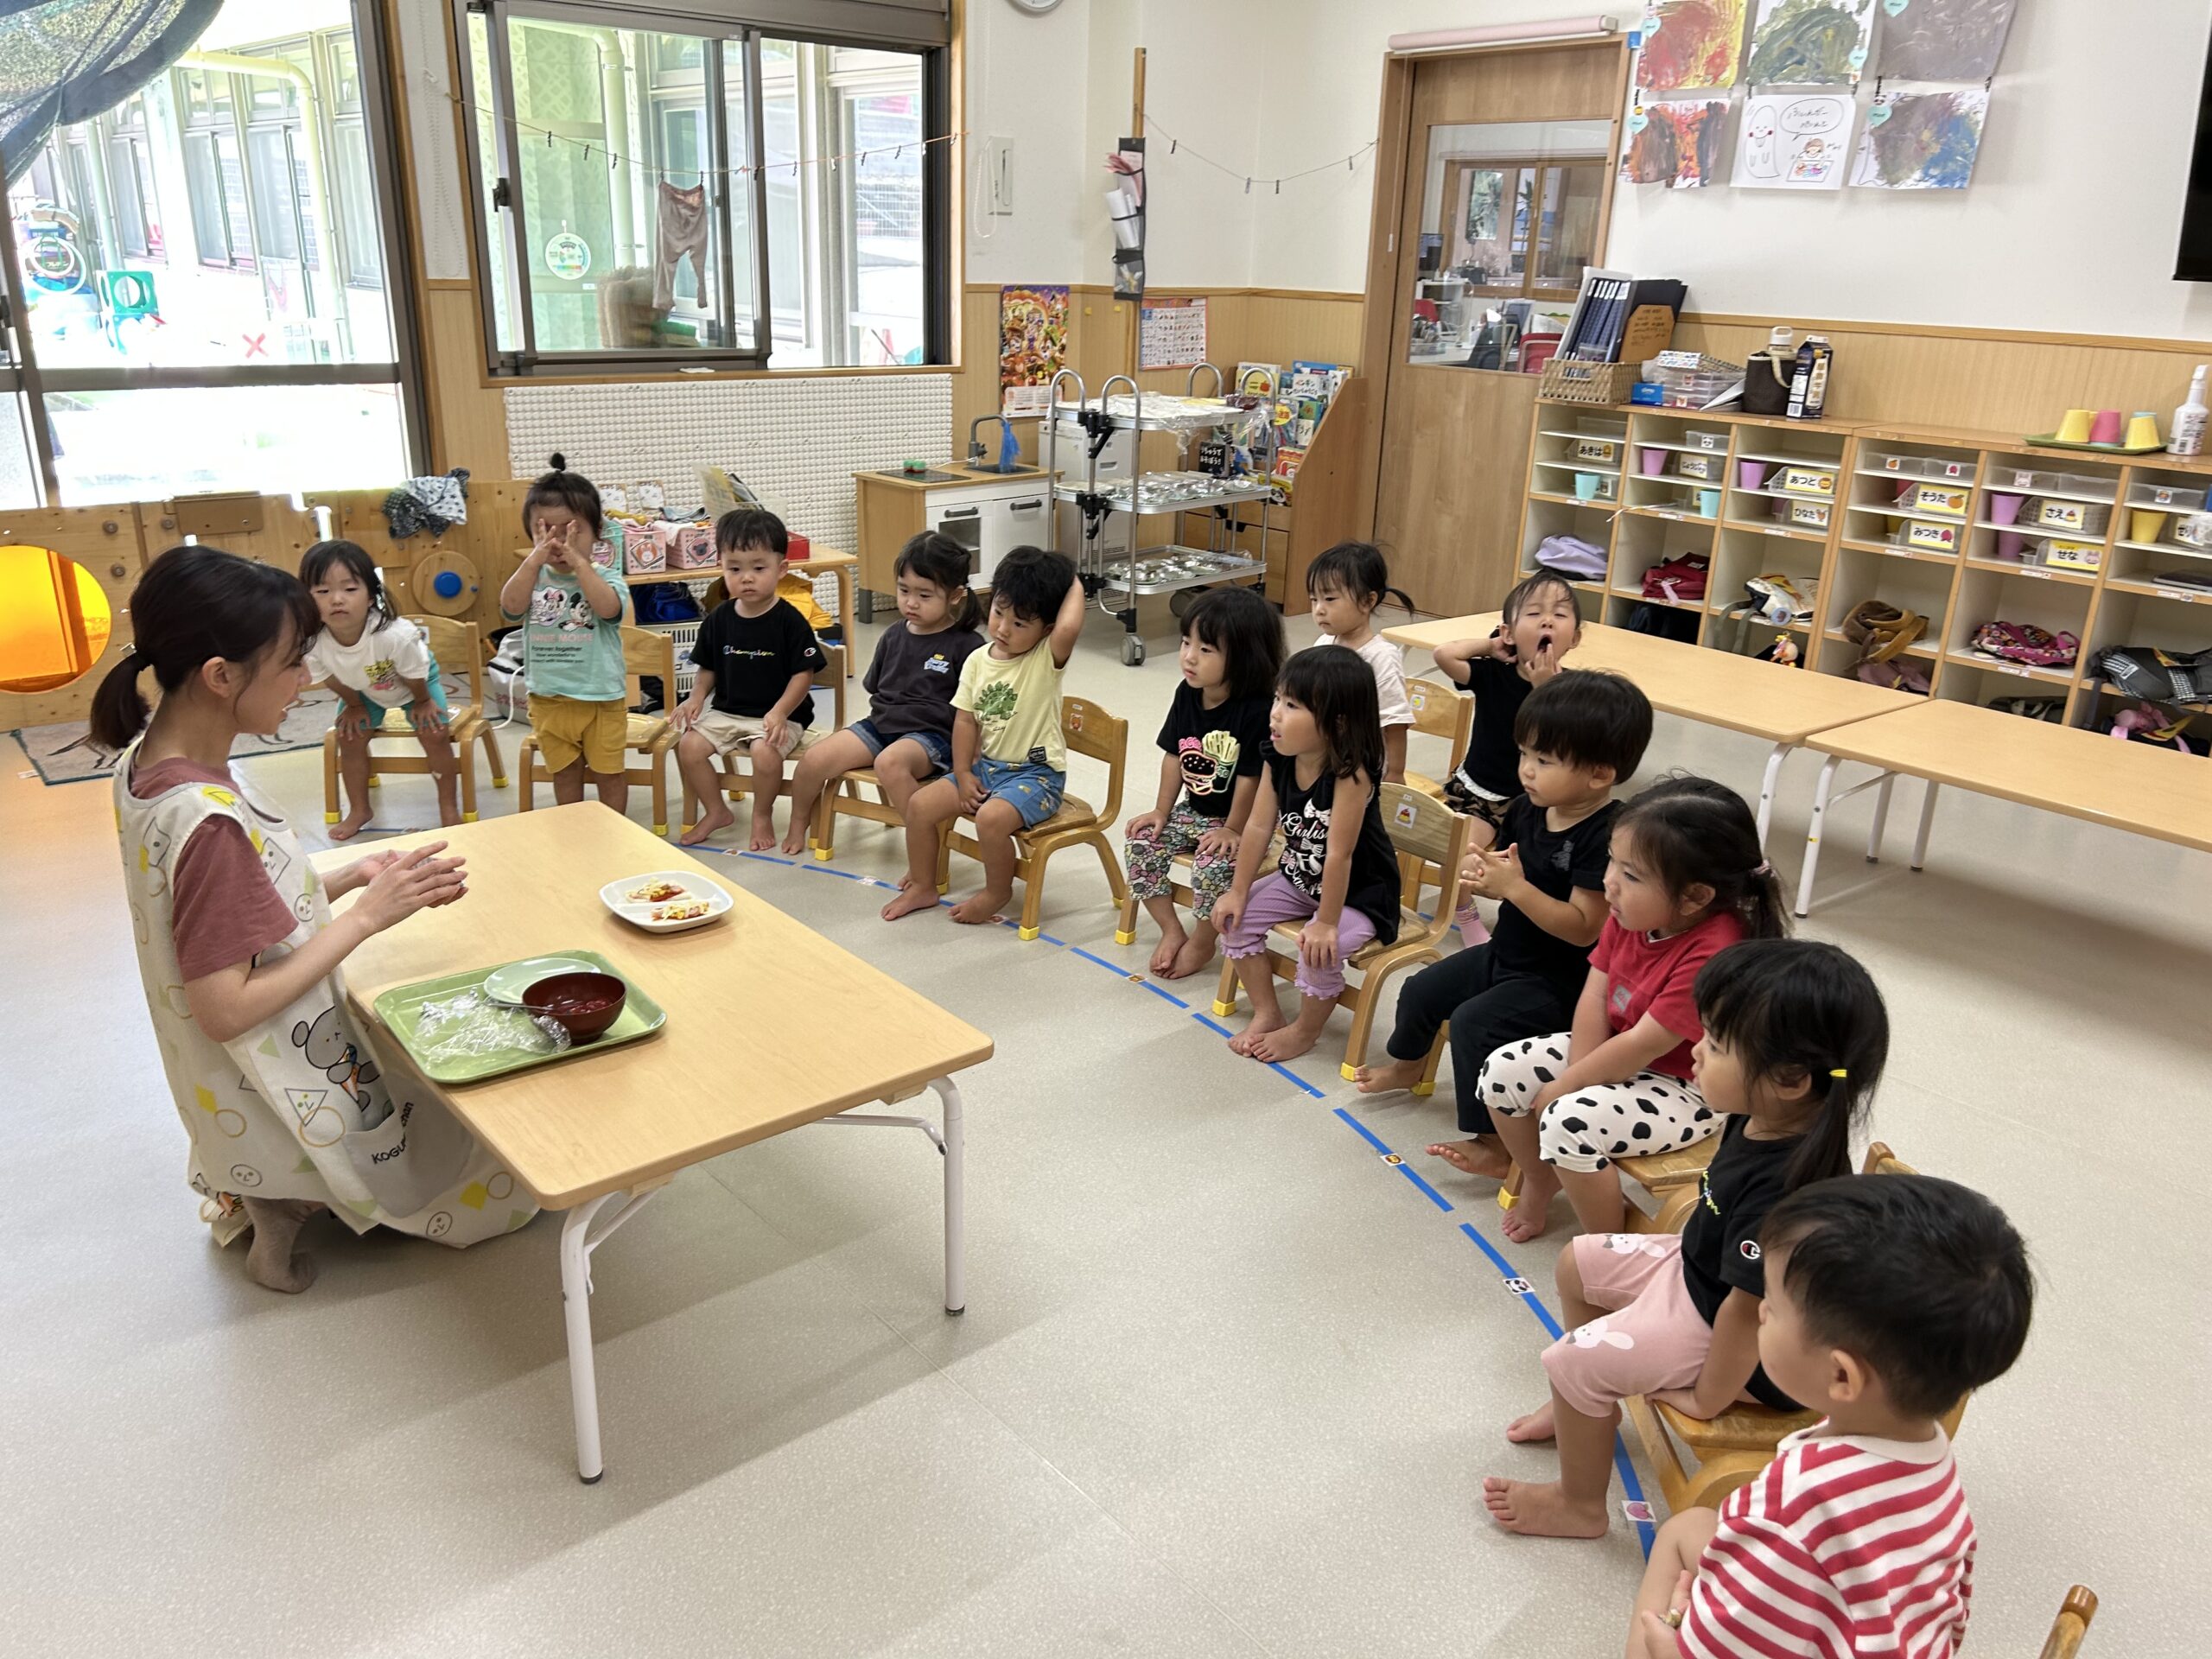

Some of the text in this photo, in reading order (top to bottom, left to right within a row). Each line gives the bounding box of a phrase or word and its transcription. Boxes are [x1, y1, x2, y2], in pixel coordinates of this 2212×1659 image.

[1580, 445, 1602, 457] あきは
[1789, 475, 1816, 486] あつと
[1920, 491, 1946, 503] そうた
[1794, 508, 1815, 519] ひなた
[2045, 508, 2064, 520] さえ
[1913, 527, 1940, 539] みつき
[2057, 550, 2078, 561] せな
[722, 645, 776, 659] Champion
[1282, 812, 1329, 840] Girlis
